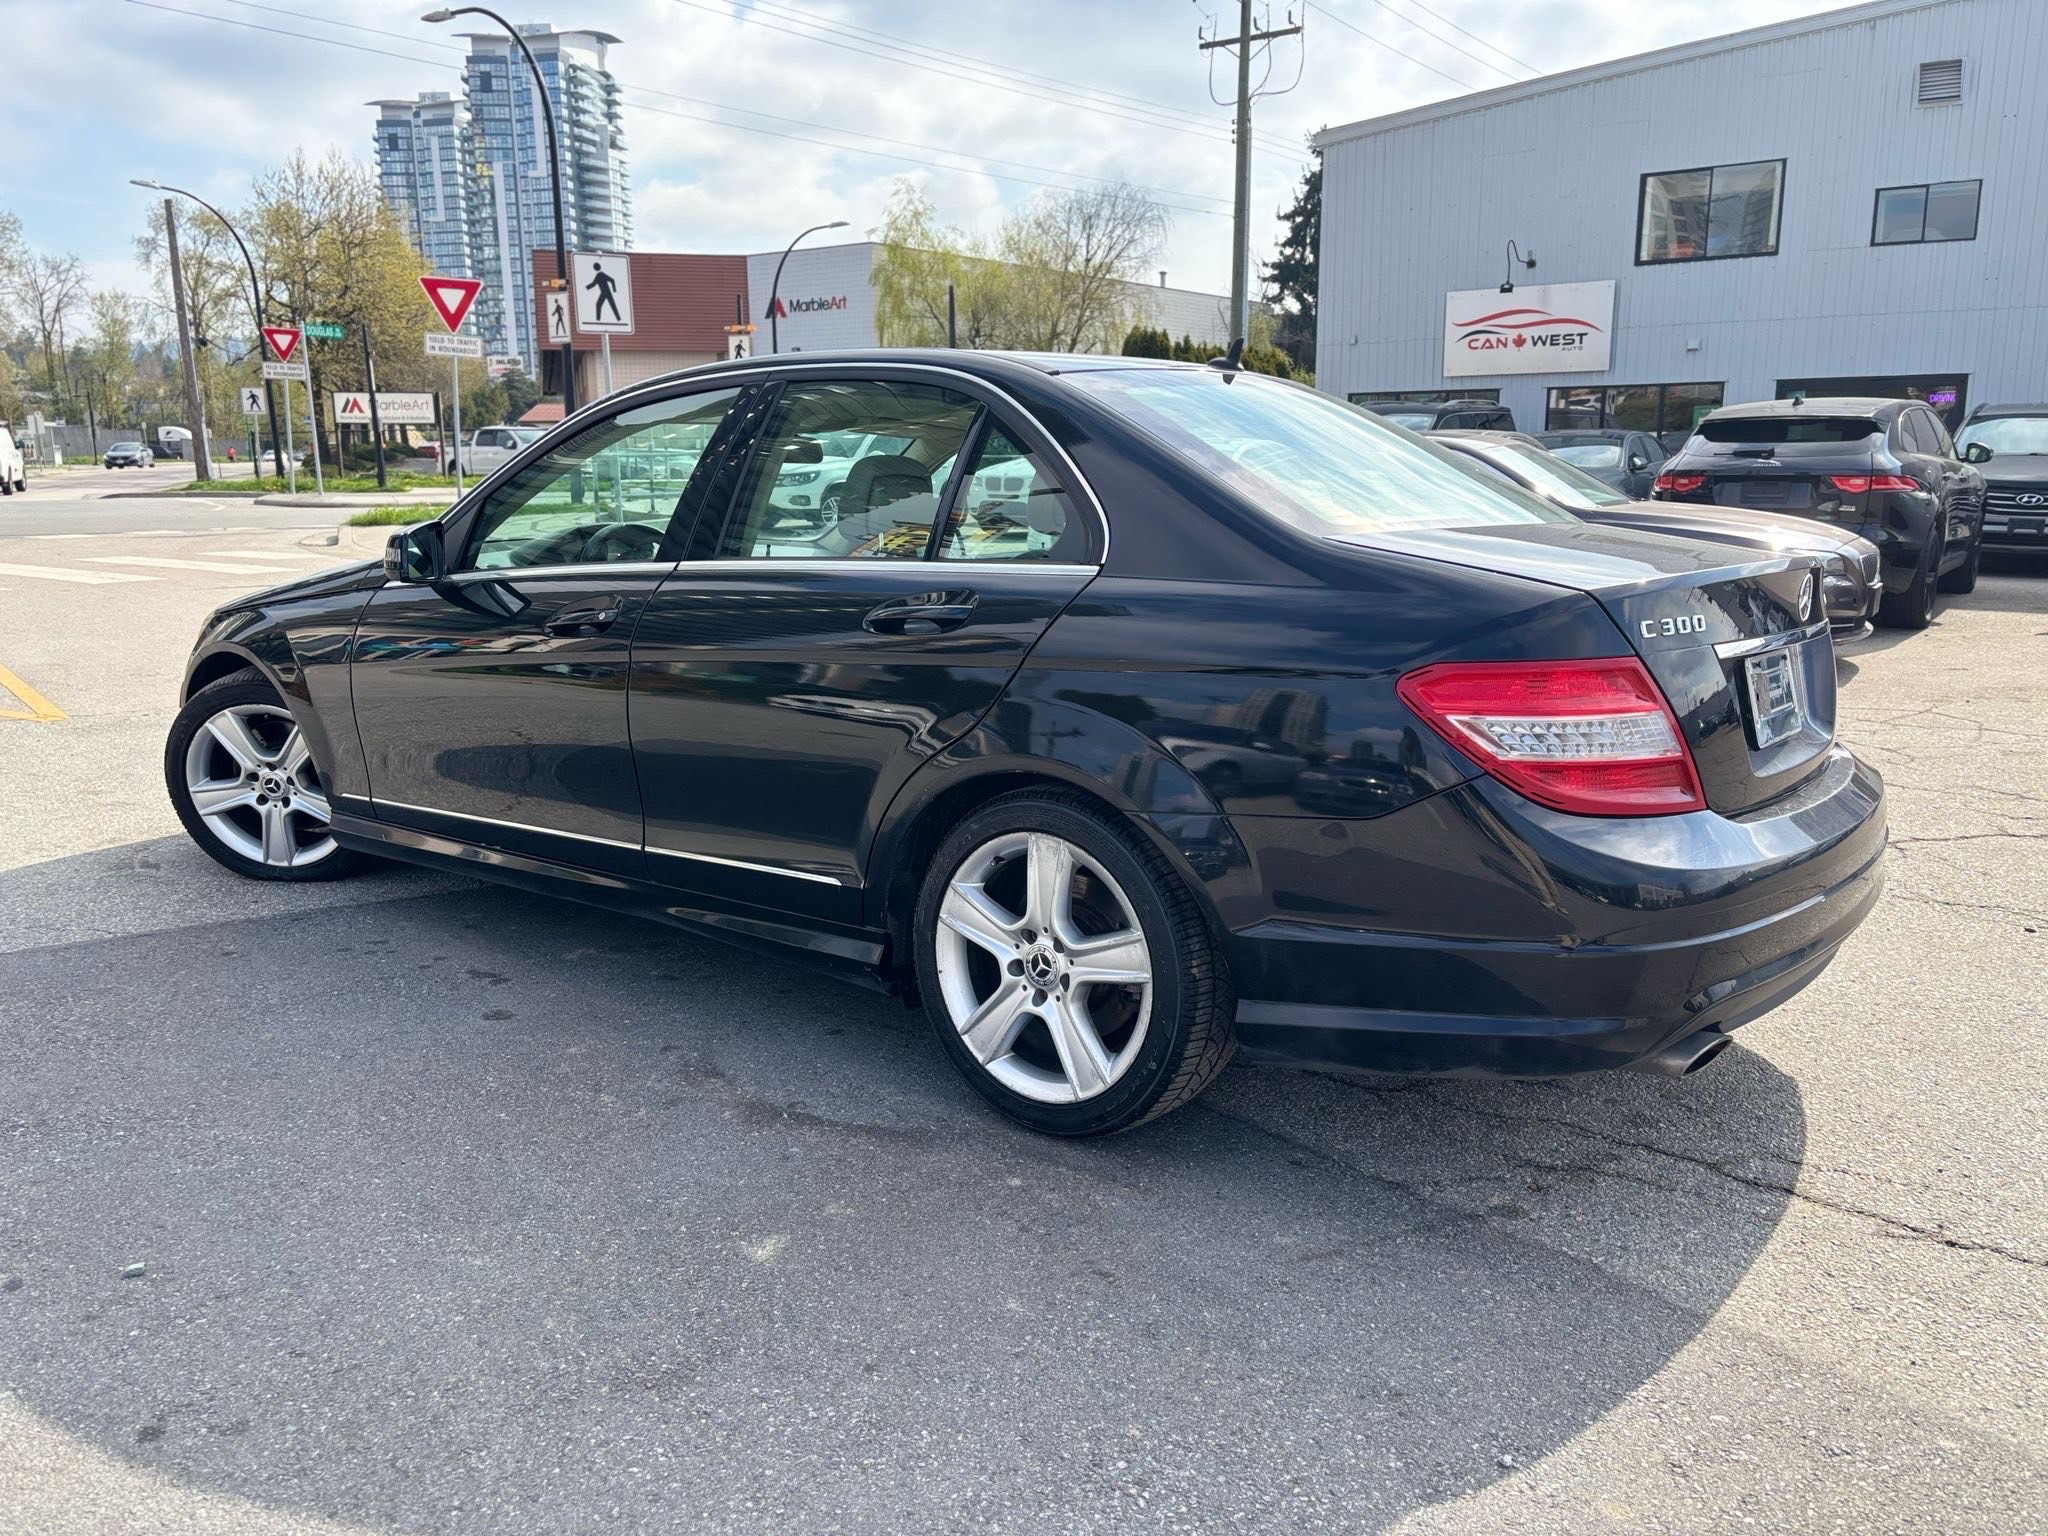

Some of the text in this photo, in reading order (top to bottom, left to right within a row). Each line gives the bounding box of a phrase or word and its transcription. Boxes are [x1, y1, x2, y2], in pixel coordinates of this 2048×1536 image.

[789, 295, 847, 312] MarbleArt
[306, 325, 334, 337] DOUGLAS
[428, 336, 479, 347] YIELD TO TRAFFIC
[1467, 332, 1589, 350] CAN WEST
[438, 345, 479, 355] ROUNDABOUT
[1639, 614, 1706, 638] C 300
